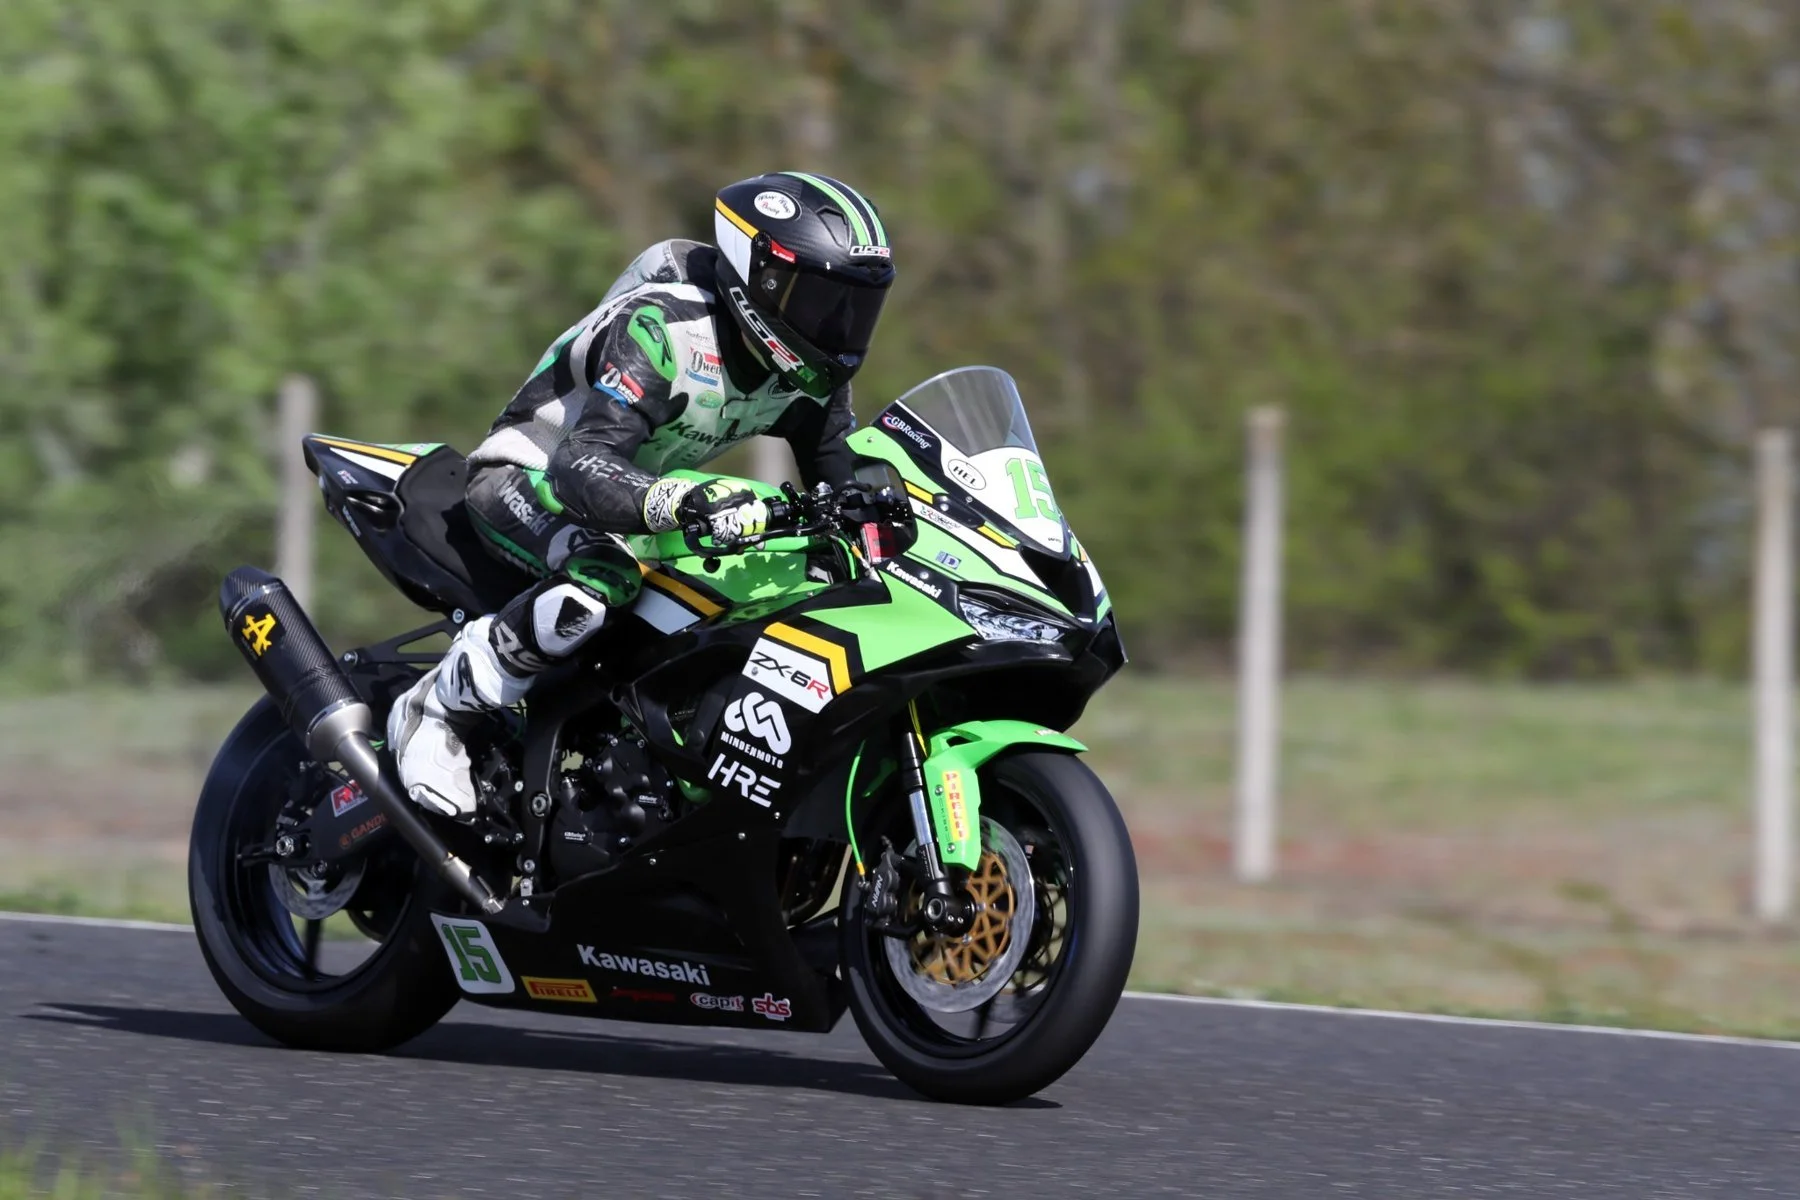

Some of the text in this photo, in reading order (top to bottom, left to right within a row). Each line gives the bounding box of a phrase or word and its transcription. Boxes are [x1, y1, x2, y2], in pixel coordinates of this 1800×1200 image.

[891, 416, 932, 449] GBRacing
[570, 454, 624, 478] HRE
[953, 466, 976, 487] HEL
[498, 473, 557, 537] wasaki
[1004, 457, 1061, 525] 15
[886, 562, 942, 598] Kawasaki
[749, 651, 830, 700] ZX-6R
[720, 731, 784, 769] MINDENMOTO
[707, 752, 782, 808] HRE
[441, 923, 502, 984] 15
[576, 943, 712, 986] Kawasaki
[528, 981, 588, 998] PIRELLI
[753, 994, 791, 1018] sbs
